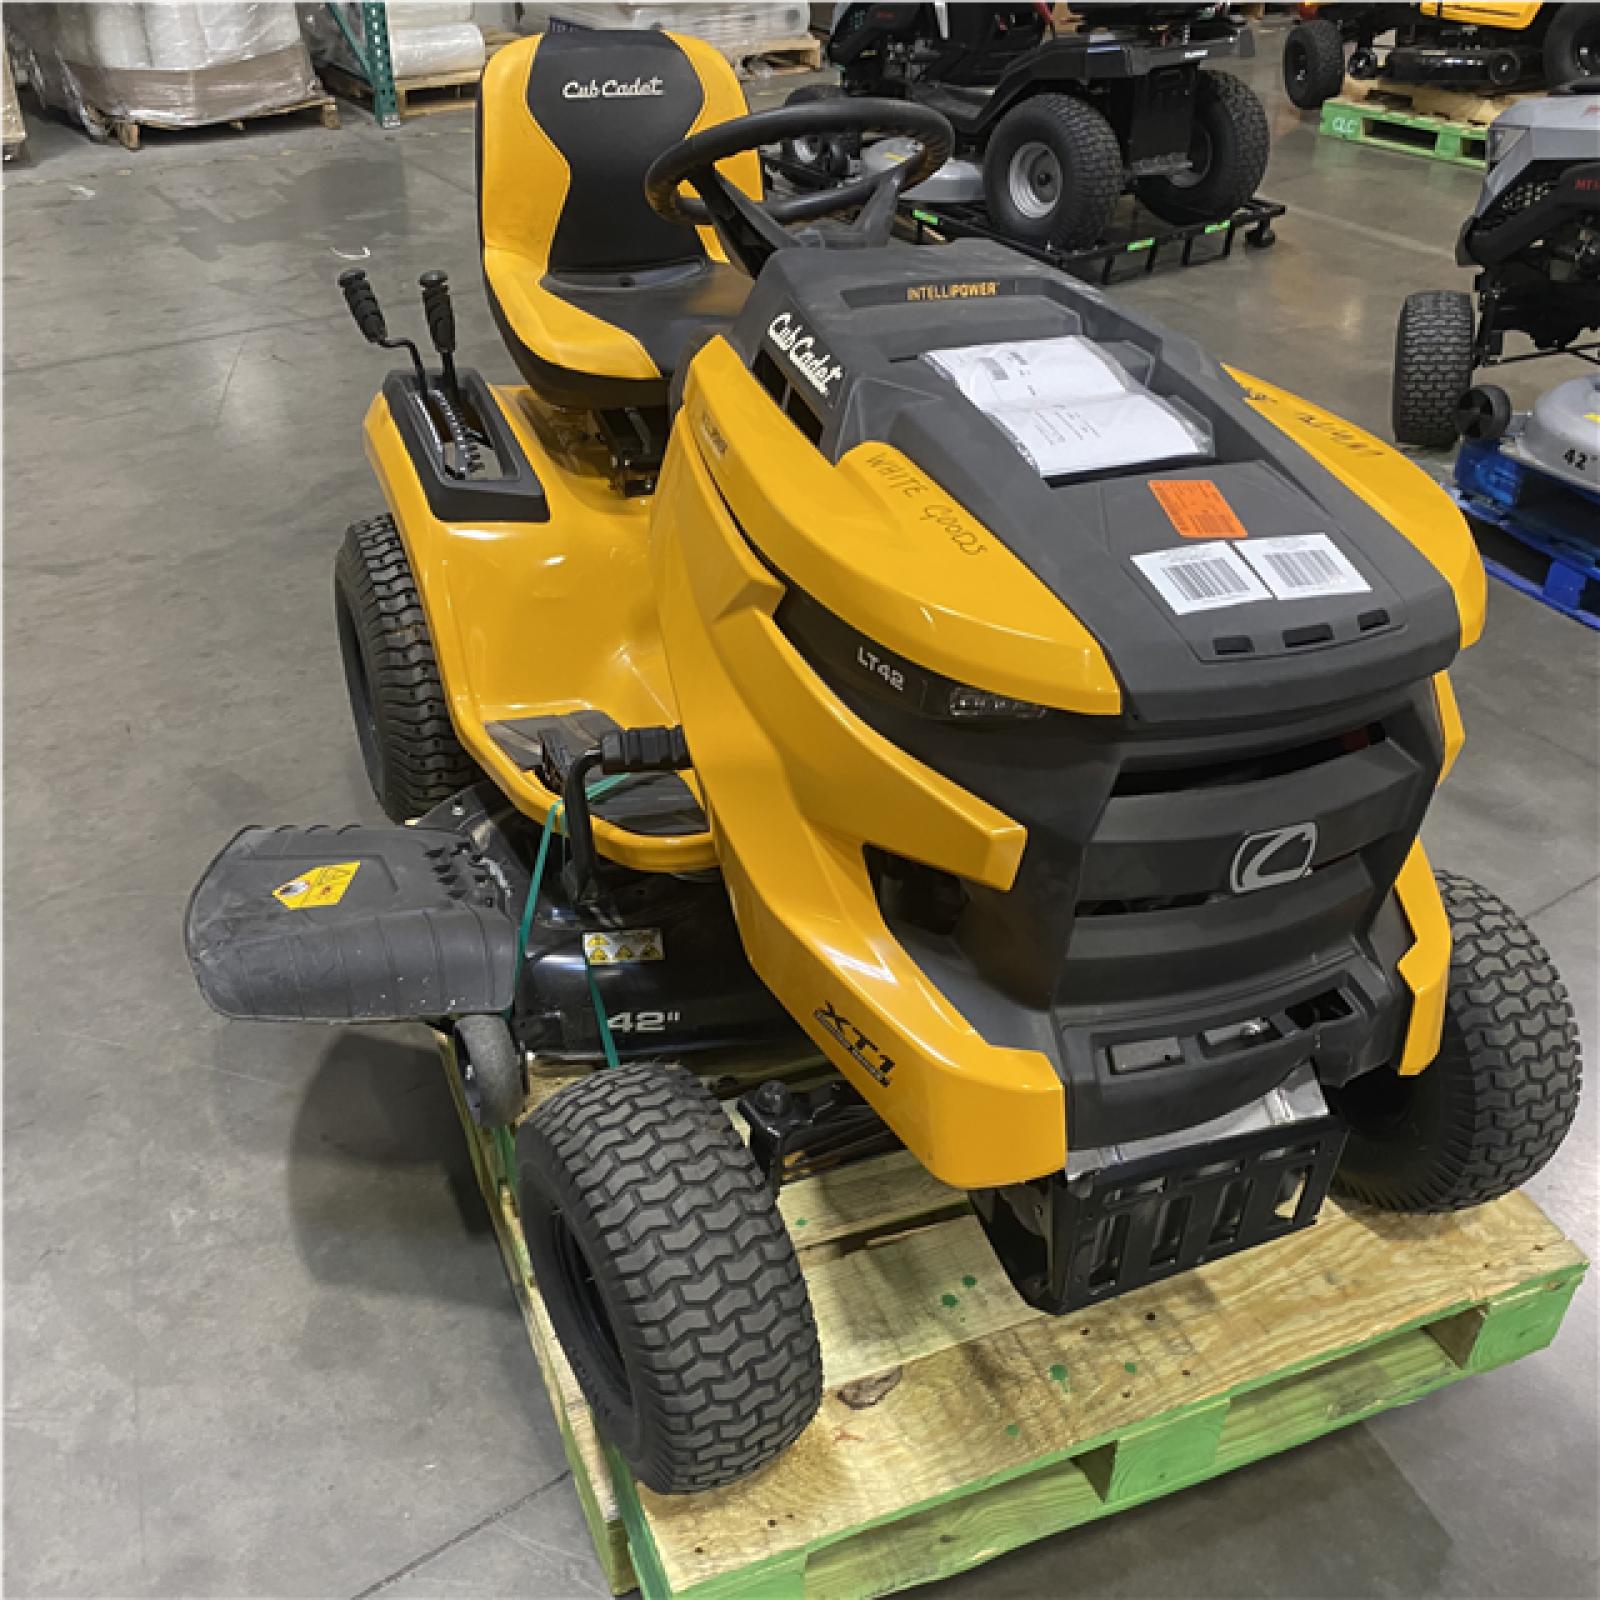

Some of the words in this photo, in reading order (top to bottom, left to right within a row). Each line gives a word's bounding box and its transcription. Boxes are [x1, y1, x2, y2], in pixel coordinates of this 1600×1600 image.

[562, 78, 600, 98] Cub
[602, 76, 664, 97] Cadet
[906, 281, 998, 301] INTELLIPOWER
[768, 312, 803, 351] Cub
[789, 336, 843, 396] Cadet
[857, 646, 904, 692] LT42
[814, 999, 896, 1074] XT1
